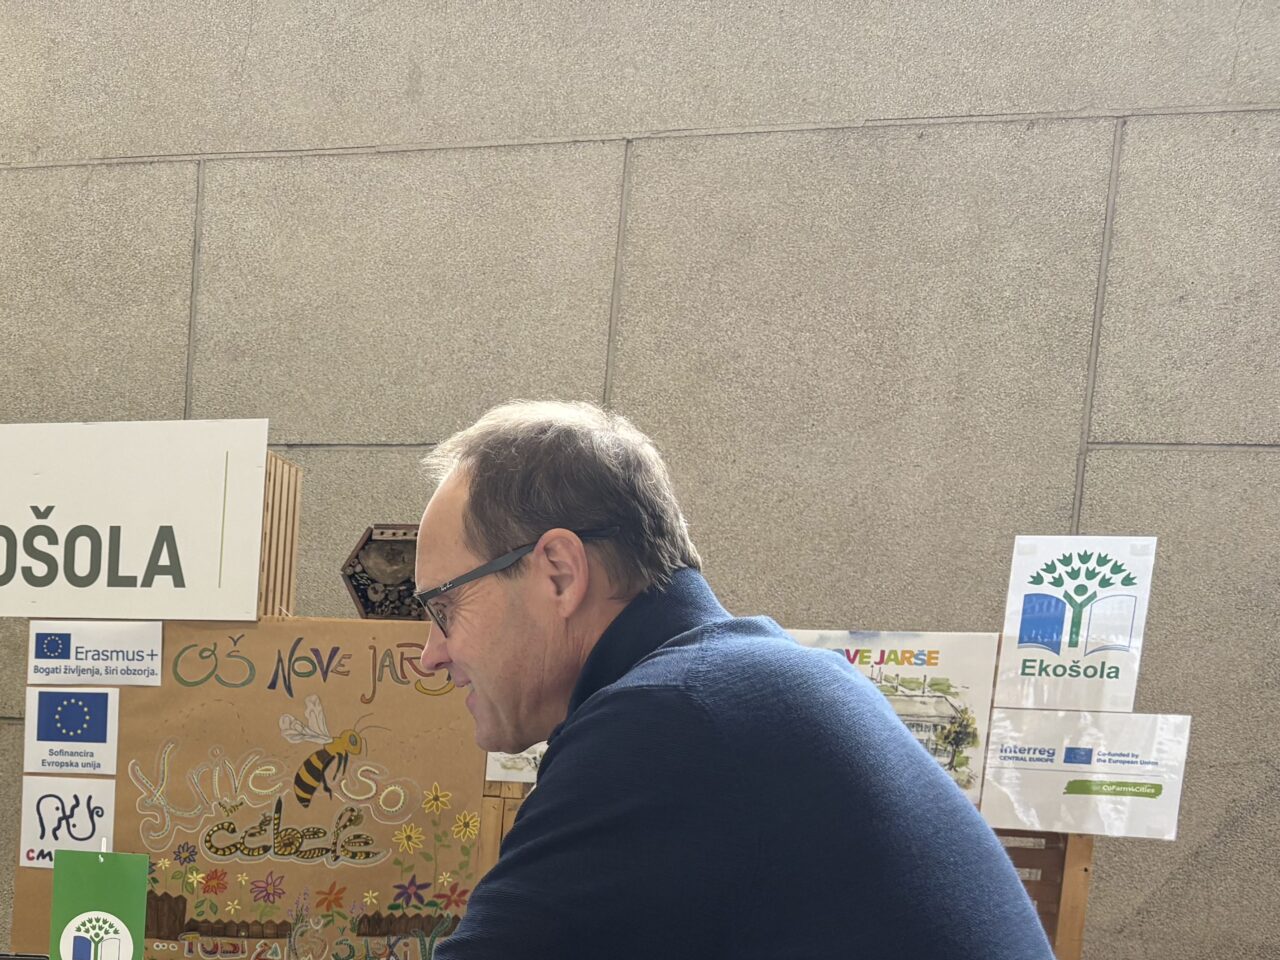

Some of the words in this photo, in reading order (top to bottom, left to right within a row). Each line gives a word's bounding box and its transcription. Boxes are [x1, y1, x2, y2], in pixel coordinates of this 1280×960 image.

[74, 645, 159, 662] Erasmus+
[874, 649, 940, 667] JARŠE
[171, 634, 257, 689] OŠ
[1020, 657, 1120, 680] Ekošola
[33, 665, 62, 677] Bogati
[63, 665, 103, 678] življenja,
[104, 664, 119, 676] širi
[120, 666, 159, 678] obzorja.
[48, 748, 95, 759] Sofinancira
[999, 743, 1056, 757] Interreg
[40, 758, 80, 770] Evropska
[80, 760, 102, 771] unija
